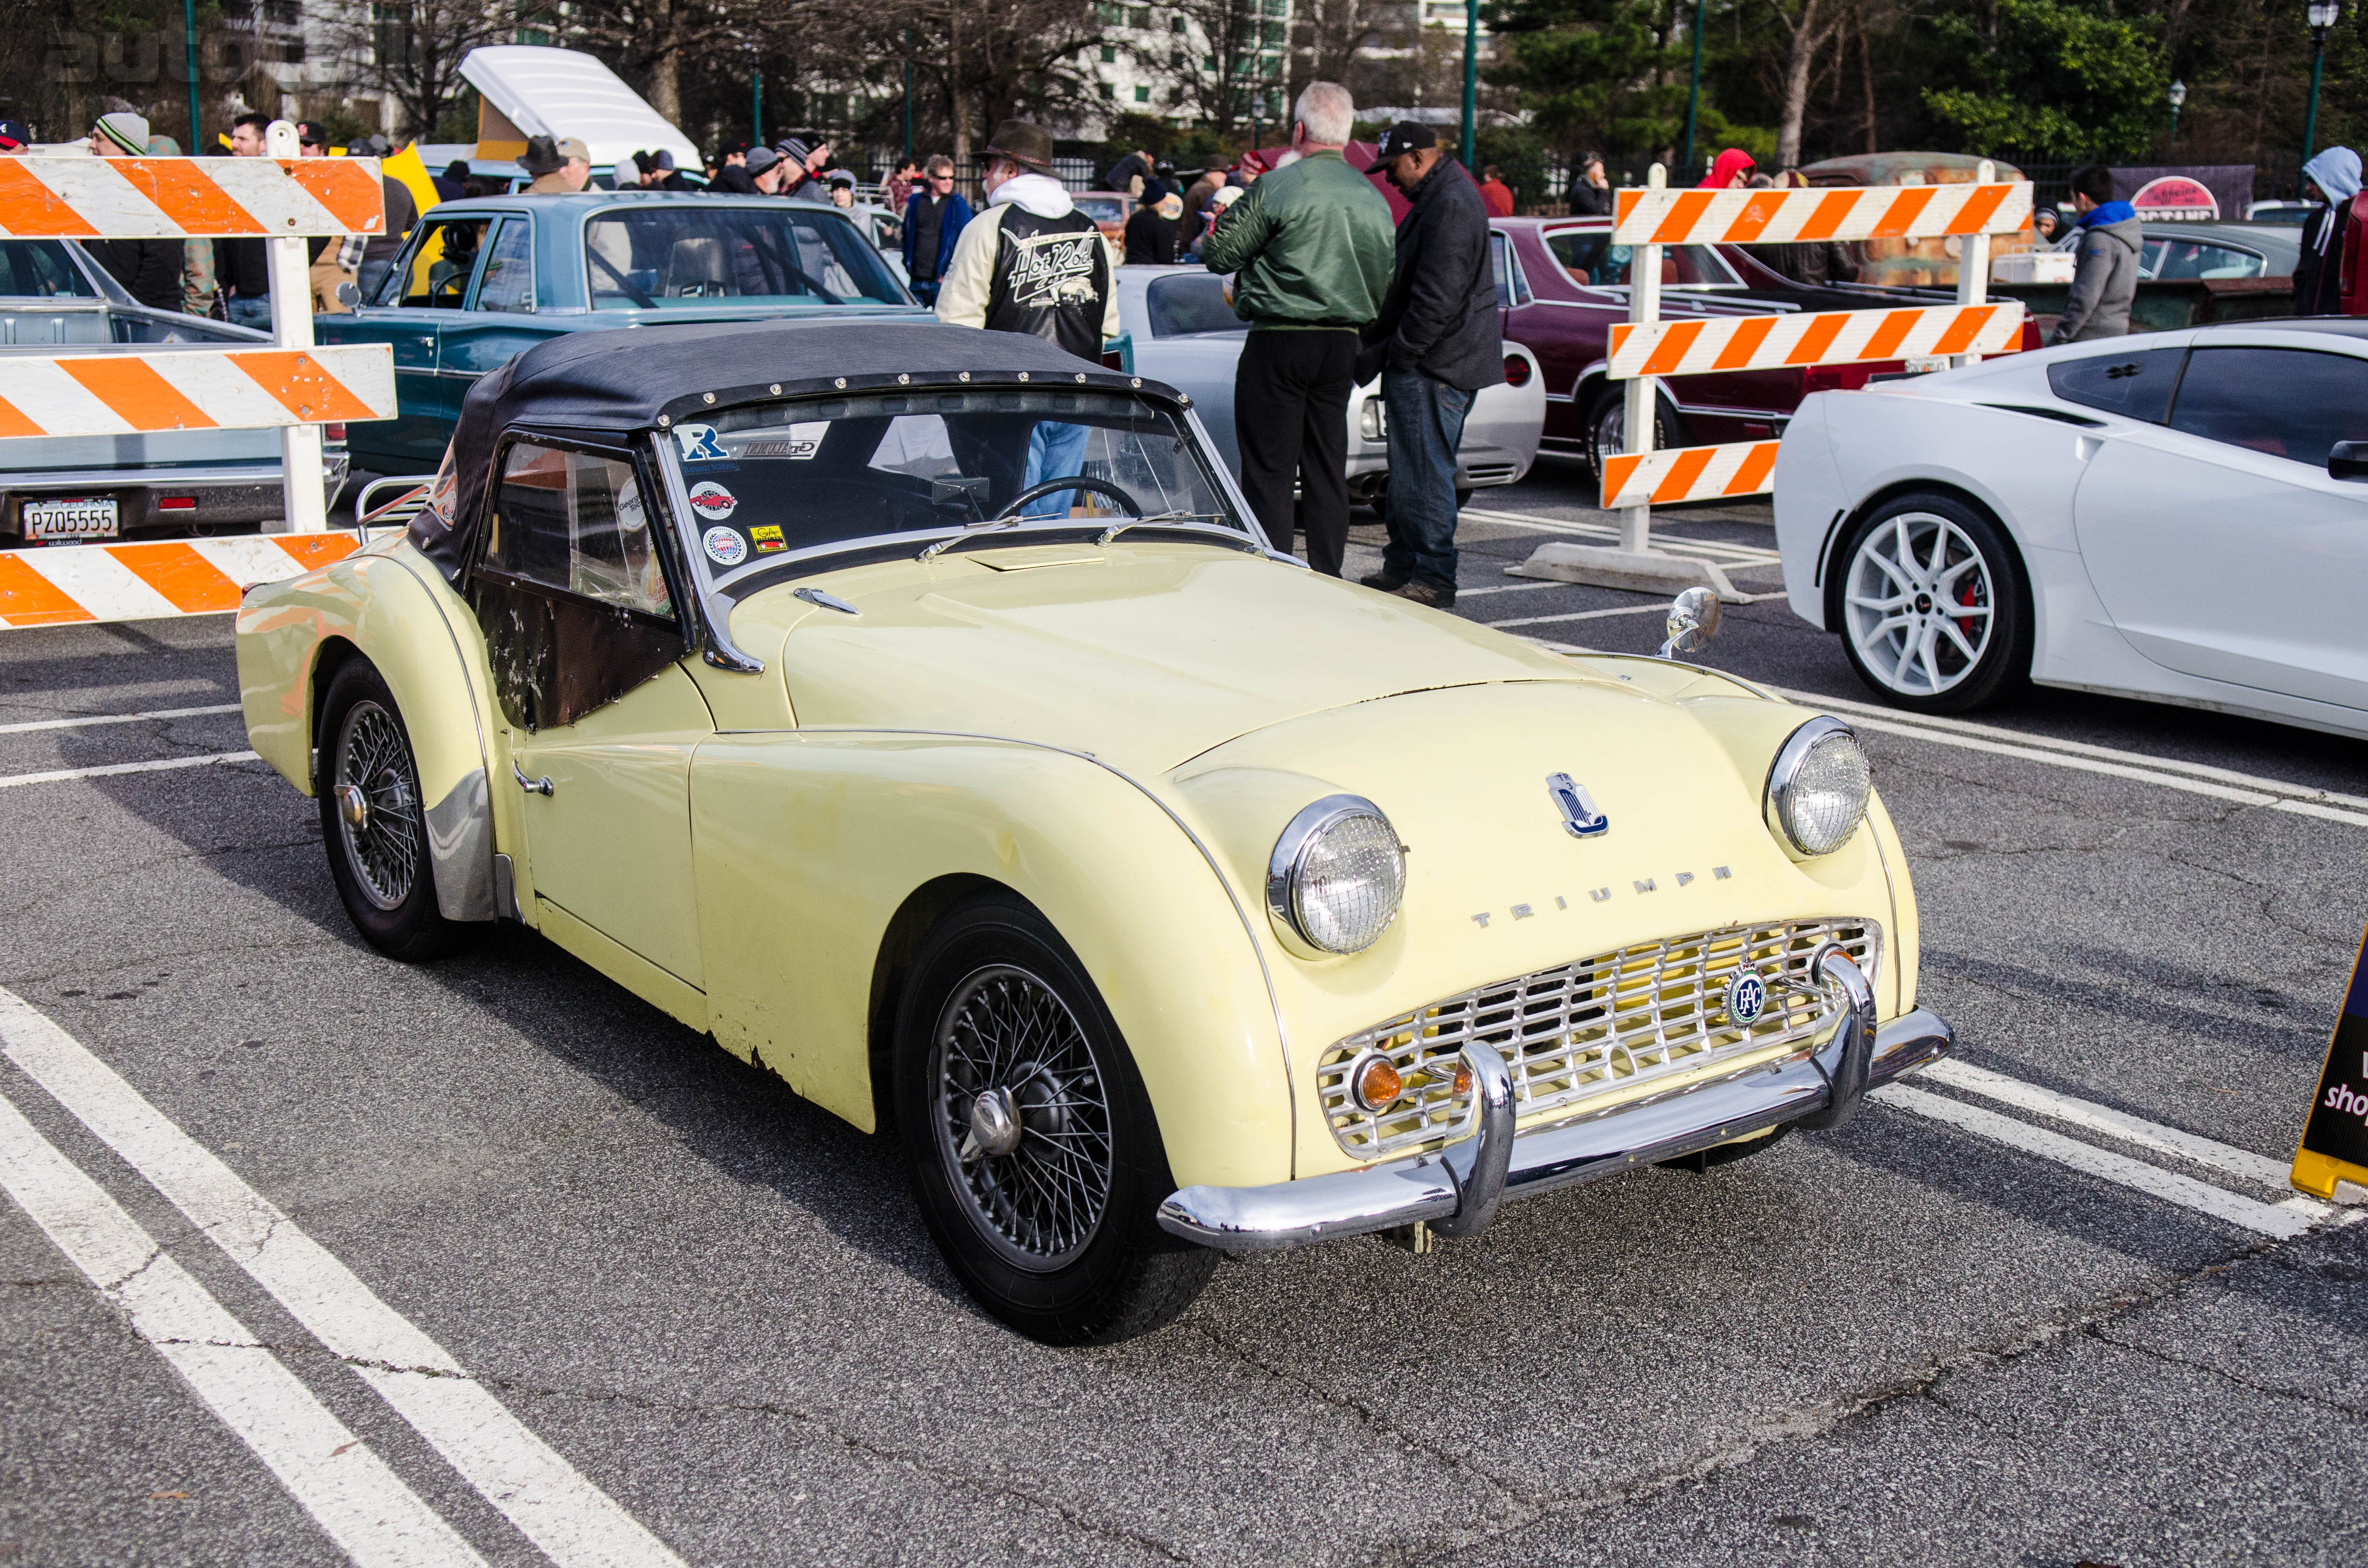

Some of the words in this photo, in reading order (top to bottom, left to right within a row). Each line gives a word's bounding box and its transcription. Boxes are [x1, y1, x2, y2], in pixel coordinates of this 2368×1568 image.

[1008, 229, 1051, 288] Hot
[1052, 239, 1094, 274] Rod
[672, 424, 730, 462] R
[619, 495, 639, 511] Georg
[629, 502, 641, 512] Tec
[32, 510, 112, 534] PZQ5555
[1470, 865, 1732, 929] TRIUMPH
[1739, 982, 1760, 1014] RAC
